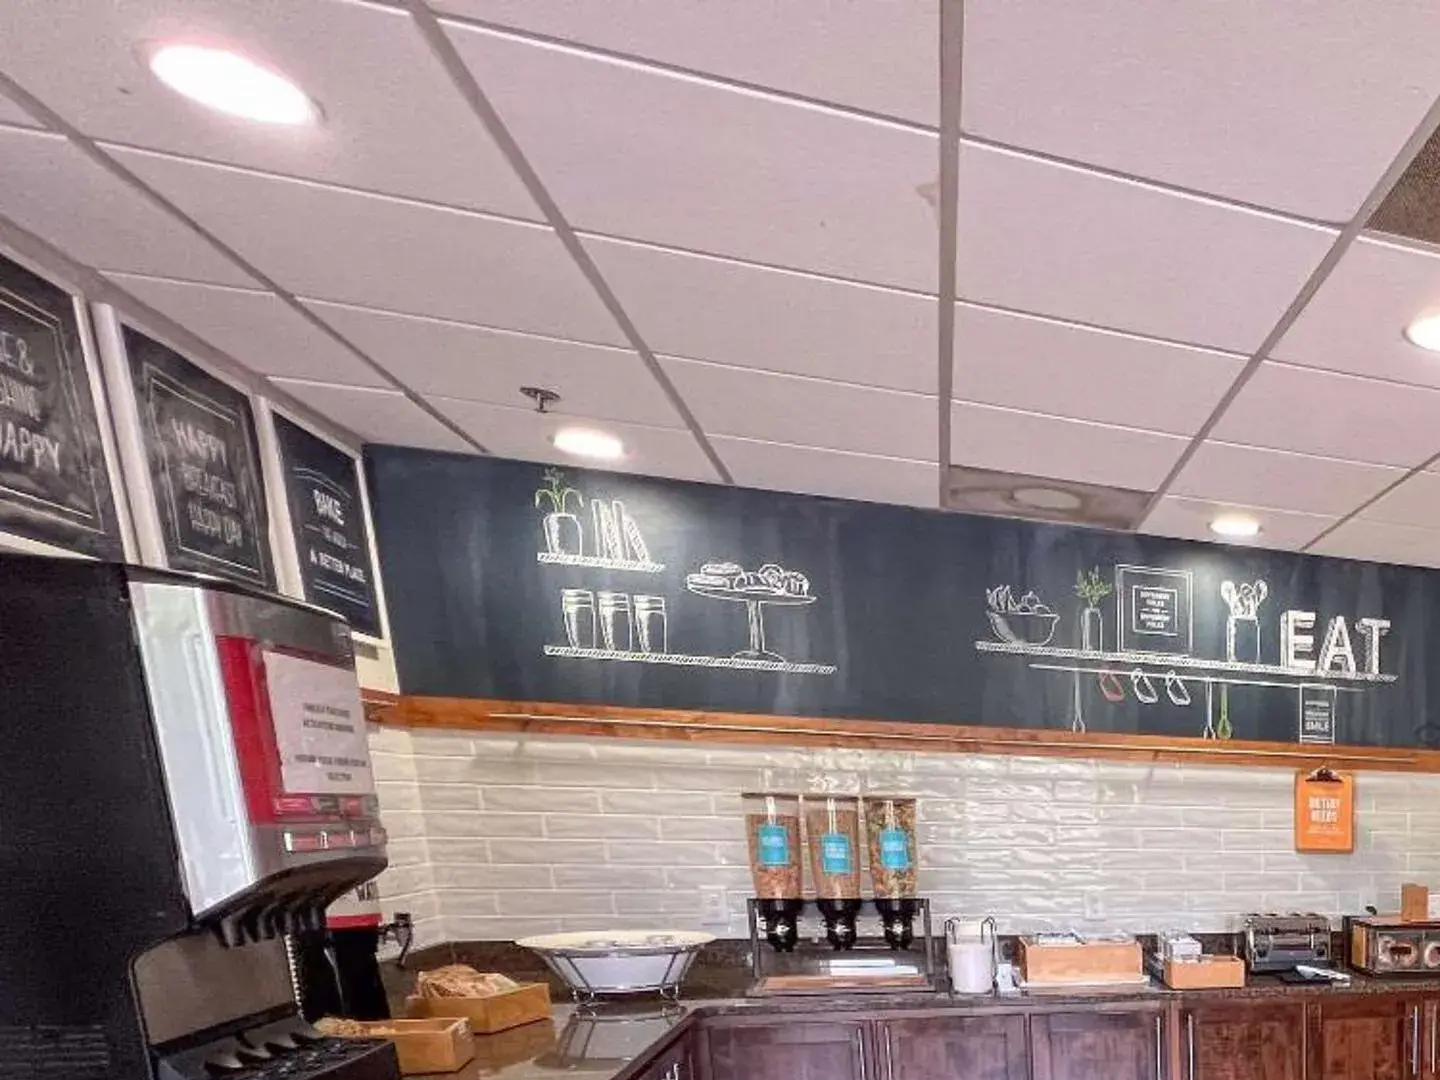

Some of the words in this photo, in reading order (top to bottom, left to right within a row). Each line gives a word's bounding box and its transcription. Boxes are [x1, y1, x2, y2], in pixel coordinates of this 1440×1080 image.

[16, 338, 34, 376] &
[0, 421, 60, 475] APPY
[1280, 610, 1391, 678] EAT
